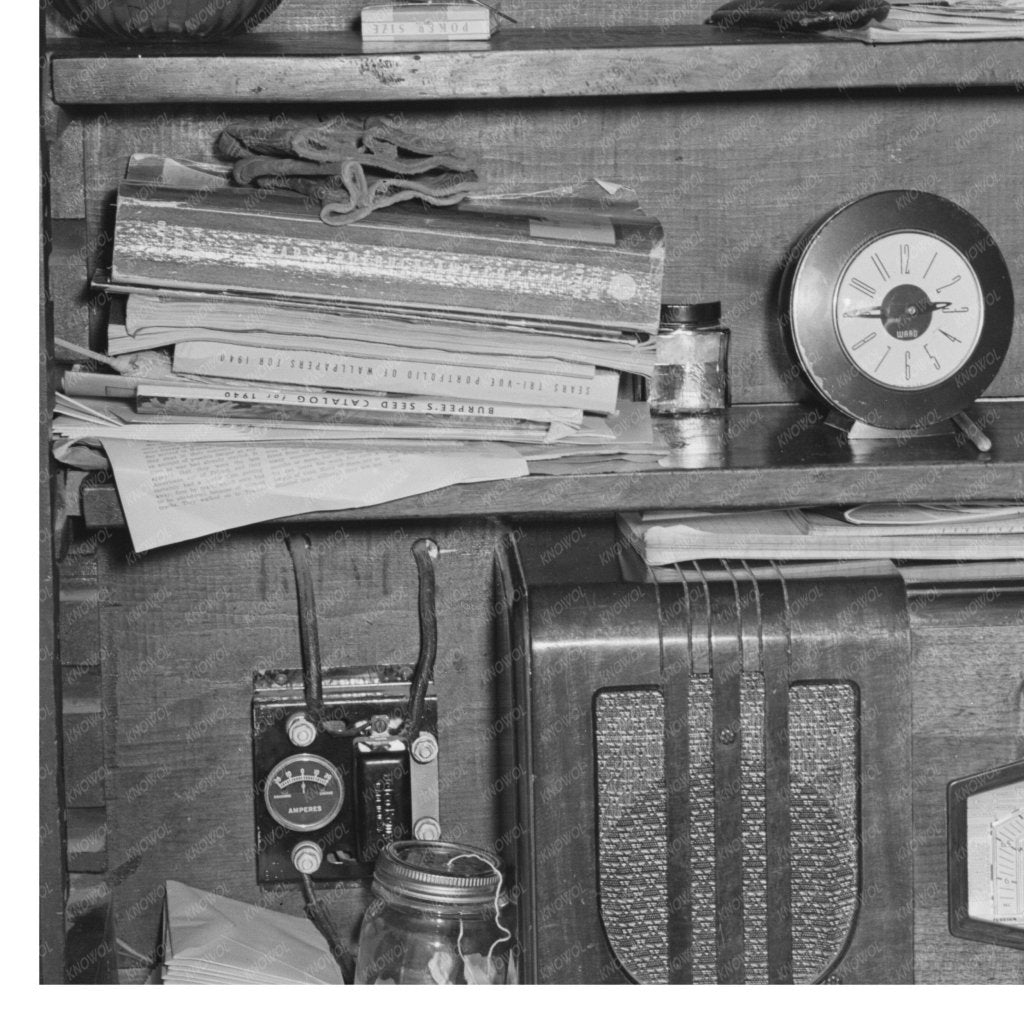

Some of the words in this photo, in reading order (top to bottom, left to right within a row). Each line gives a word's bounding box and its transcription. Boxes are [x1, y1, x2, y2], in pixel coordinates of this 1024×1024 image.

[372, 23, 405, 34] SIZE
[418, 22, 469, 34] POKER
[290, 359, 374, 376] WALLPAPERS
[384, 367, 397, 378] OF
[407, 370, 480, 386] PORTFOLIO
[224, 391, 256, 400] 1940
[297, 394, 370, 408] CATALOG
[380, 399, 416, 411] SEED
[426, 403, 495, 415] BURPEE'S
[288, 805, 322, 814] AMPERES
